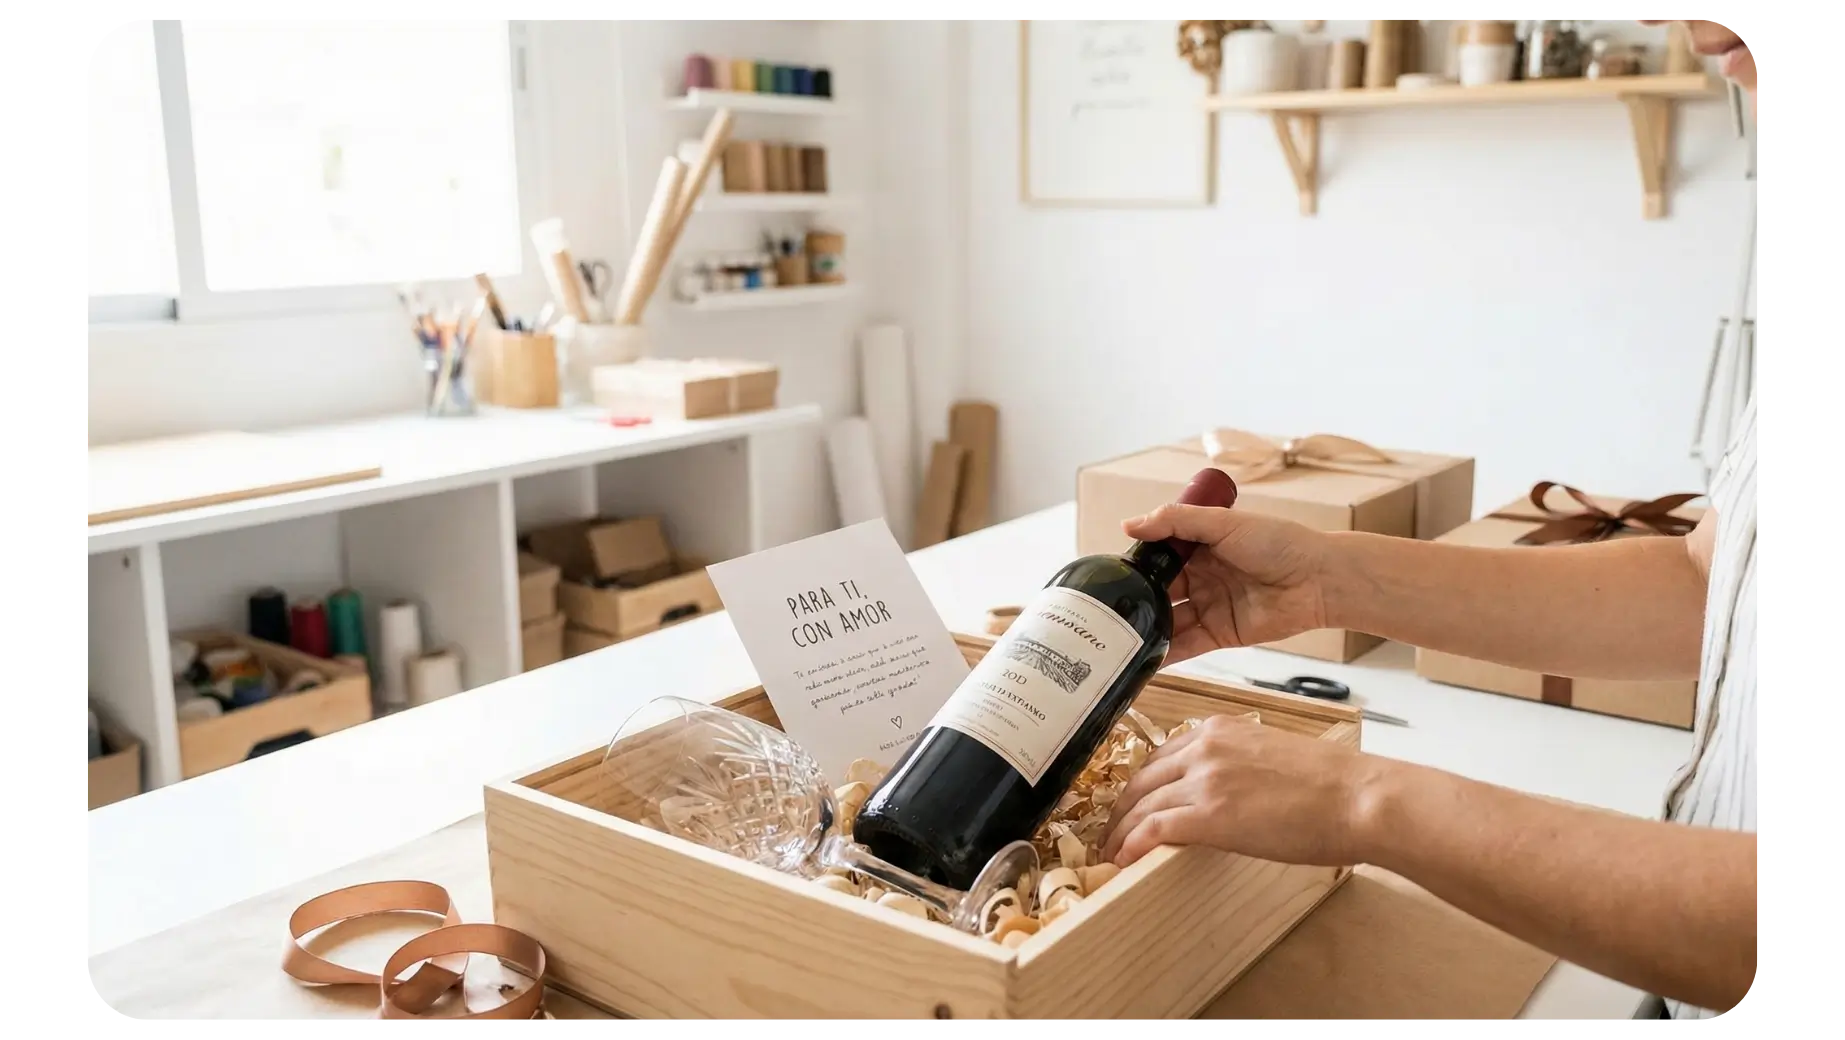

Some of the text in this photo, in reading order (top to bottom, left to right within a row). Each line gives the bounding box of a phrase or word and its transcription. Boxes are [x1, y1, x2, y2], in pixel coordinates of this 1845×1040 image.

[786, 579, 868, 619] PARA TI,
[791, 600, 892, 648] CON AMOR
